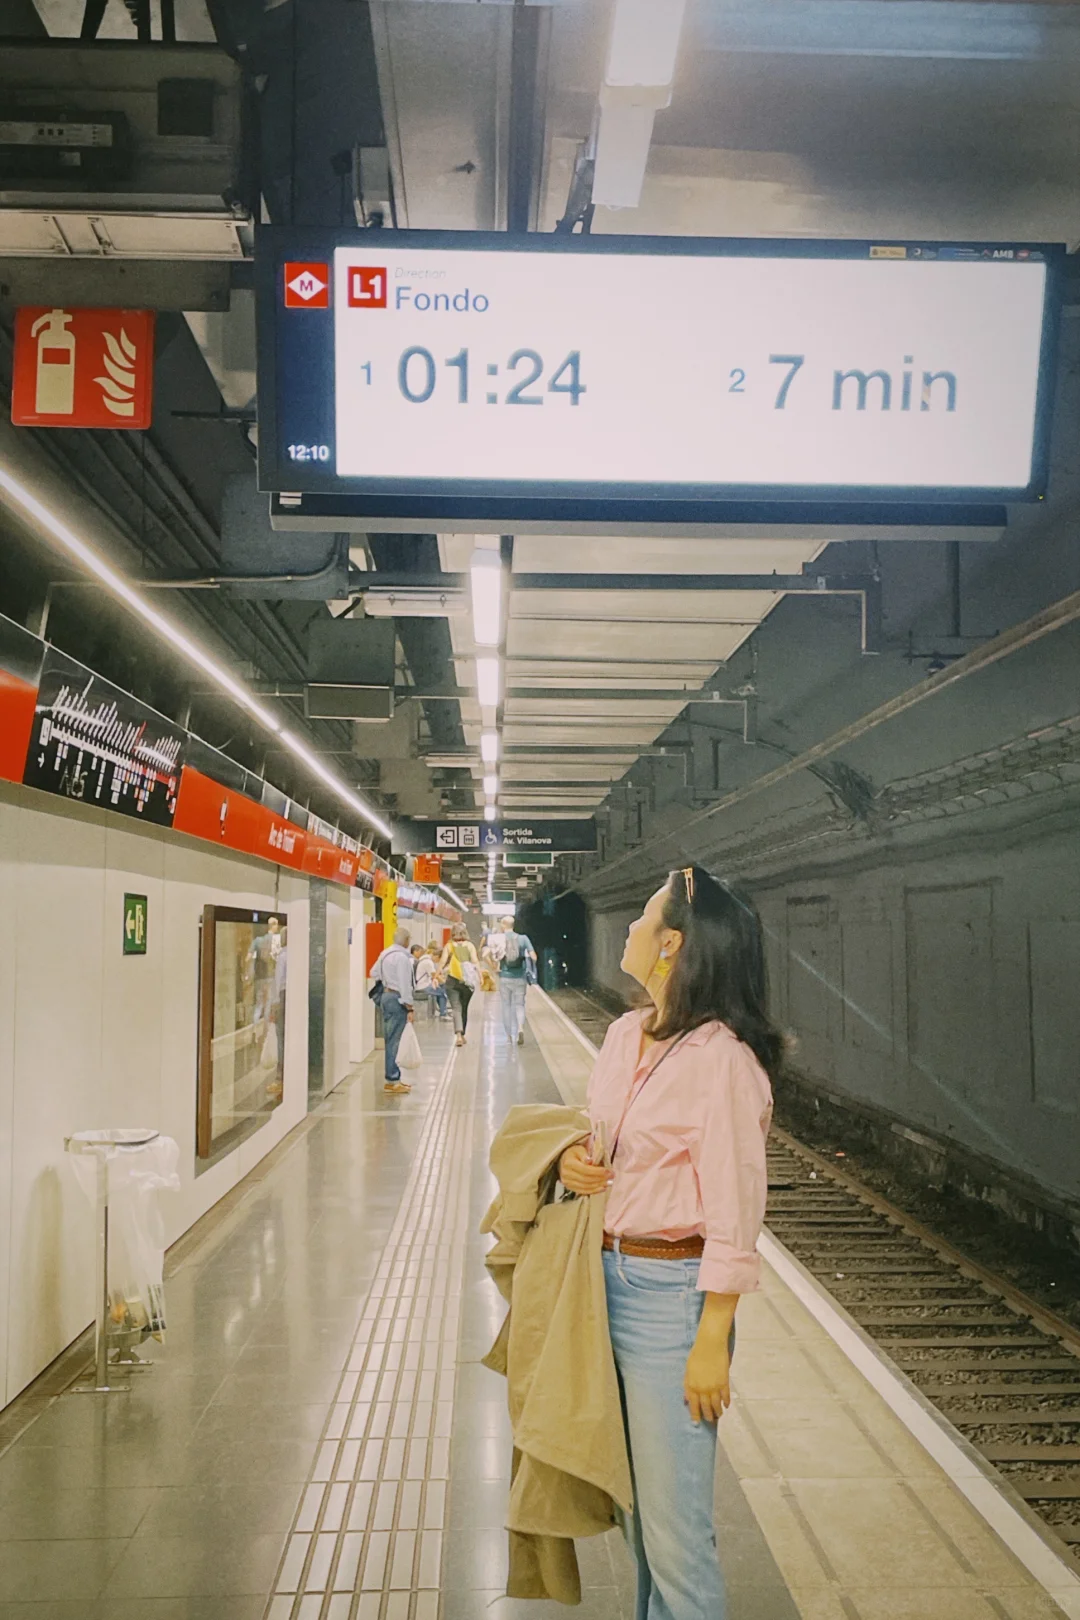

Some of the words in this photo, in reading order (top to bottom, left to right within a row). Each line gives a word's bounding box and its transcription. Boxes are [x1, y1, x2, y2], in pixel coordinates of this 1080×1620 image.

[394, 267, 447, 279] Direction
[299, 279, 313, 292] M
[352, 273, 382, 299] L1
[395, 286, 489, 313] Fondo
[360, 360, 373, 386] 1
[397, 345, 587, 406] 01:24
[728, 368, 746, 393] 2
[768, 353, 805, 410] 7
[831, 354, 958, 412] min
[287, 444, 330, 461] 12:10
[502, 828, 533, 836] Sortida
[502, 837, 515, 845] Av.
[517, 837, 552, 845] Vilanova
